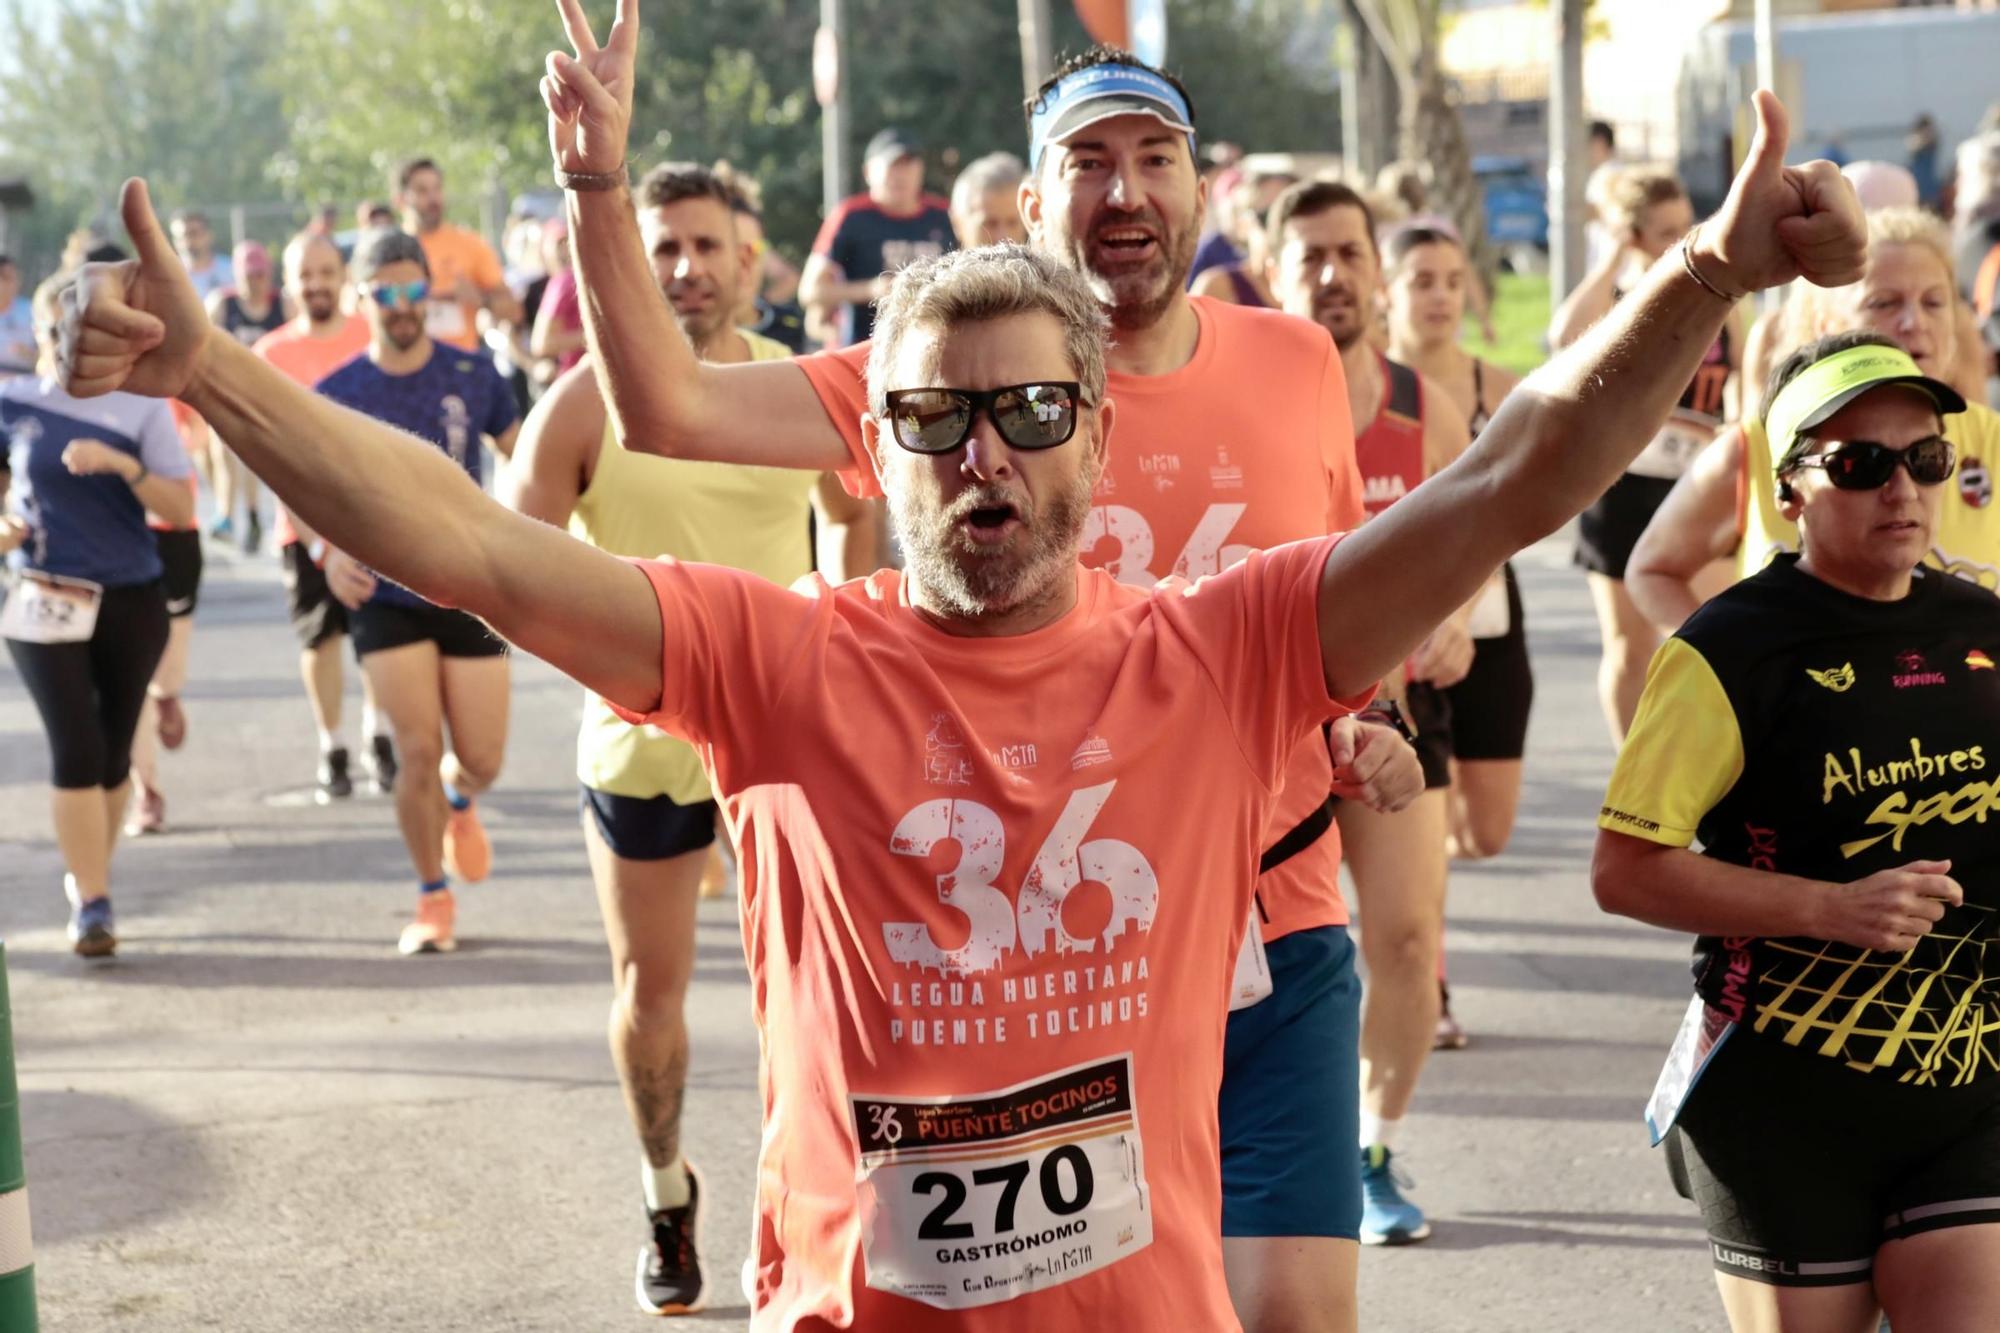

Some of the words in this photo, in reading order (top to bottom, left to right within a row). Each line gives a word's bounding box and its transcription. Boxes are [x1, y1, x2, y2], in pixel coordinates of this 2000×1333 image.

[1823, 737, 1986, 804] Alumbres
[882, 778, 1160, 981] 36
[892, 982, 985, 1007] LEGUA
[1004, 956, 1149, 1003] HUERTANA
[891, 1017, 1007, 1046] PUENTE
[1026, 993, 1148, 1039] TOCINOS
[867, 1104, 903, 1143] 36
[917, 1110, 1014, 1140] PUENTE
[1016, 1075, 1118, 1126] TOCINOS
[911, 1143, 1094, 1240] 270
[936, 1219, 1088, 1265] GASTRÓNOMO
[1714, 1244, 1796, 1275] LURBEL
